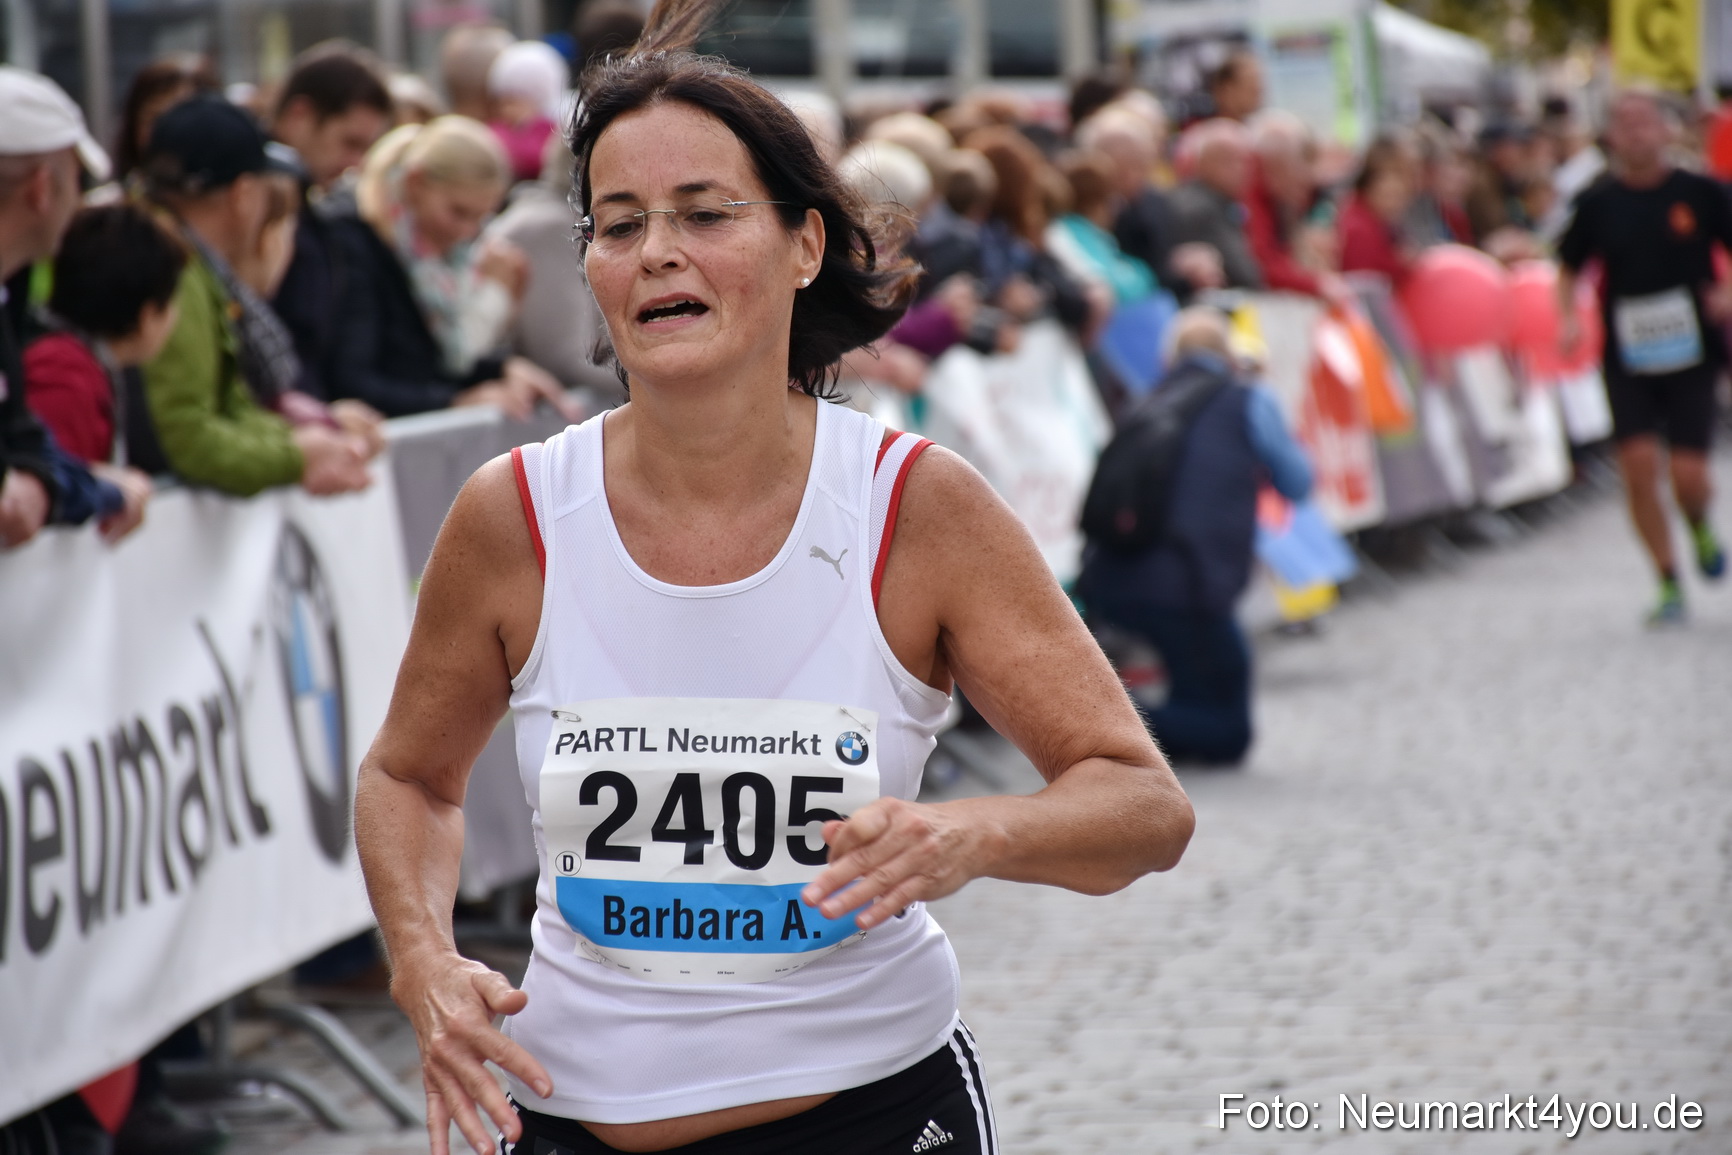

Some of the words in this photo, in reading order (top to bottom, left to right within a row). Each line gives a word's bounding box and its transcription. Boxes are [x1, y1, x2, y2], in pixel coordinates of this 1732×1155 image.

[555, 727, 658, 755] PARTL
[667, 728, 822, 756] Neumarkt
[839, 732, 867, 746] BMW
[579, 770, 849, 871] 2405
[562, 854, 575, 872] D
[603, 895, 764, 941] Barbara
[780, 898, 822, 941] A.
[912, 1131, 954, 1153] adidas
